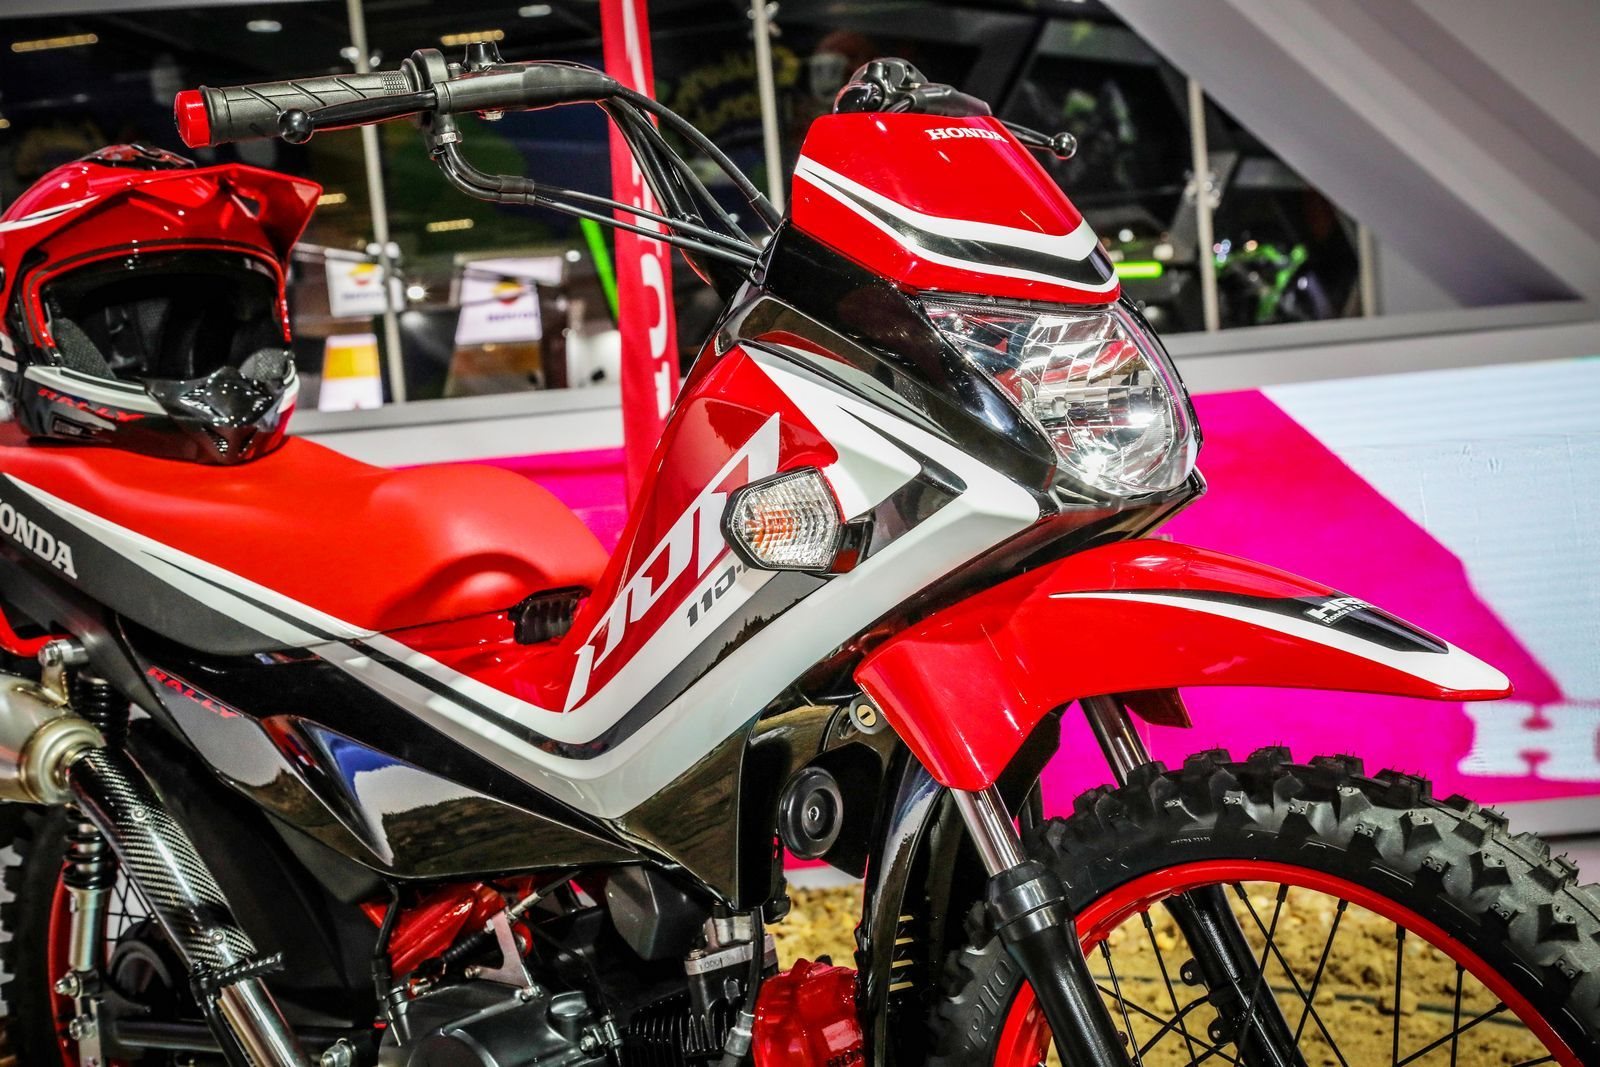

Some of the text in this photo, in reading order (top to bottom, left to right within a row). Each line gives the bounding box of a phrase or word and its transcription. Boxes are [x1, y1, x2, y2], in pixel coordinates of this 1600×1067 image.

[924, 127, 1009, 143] HONDA
[38, 387, 145, 422] RALLY
[0, 498, 78, 580] ONDA
[146, 666, 239, 718] RALLY
[1457, 700, 1600, 782] H
